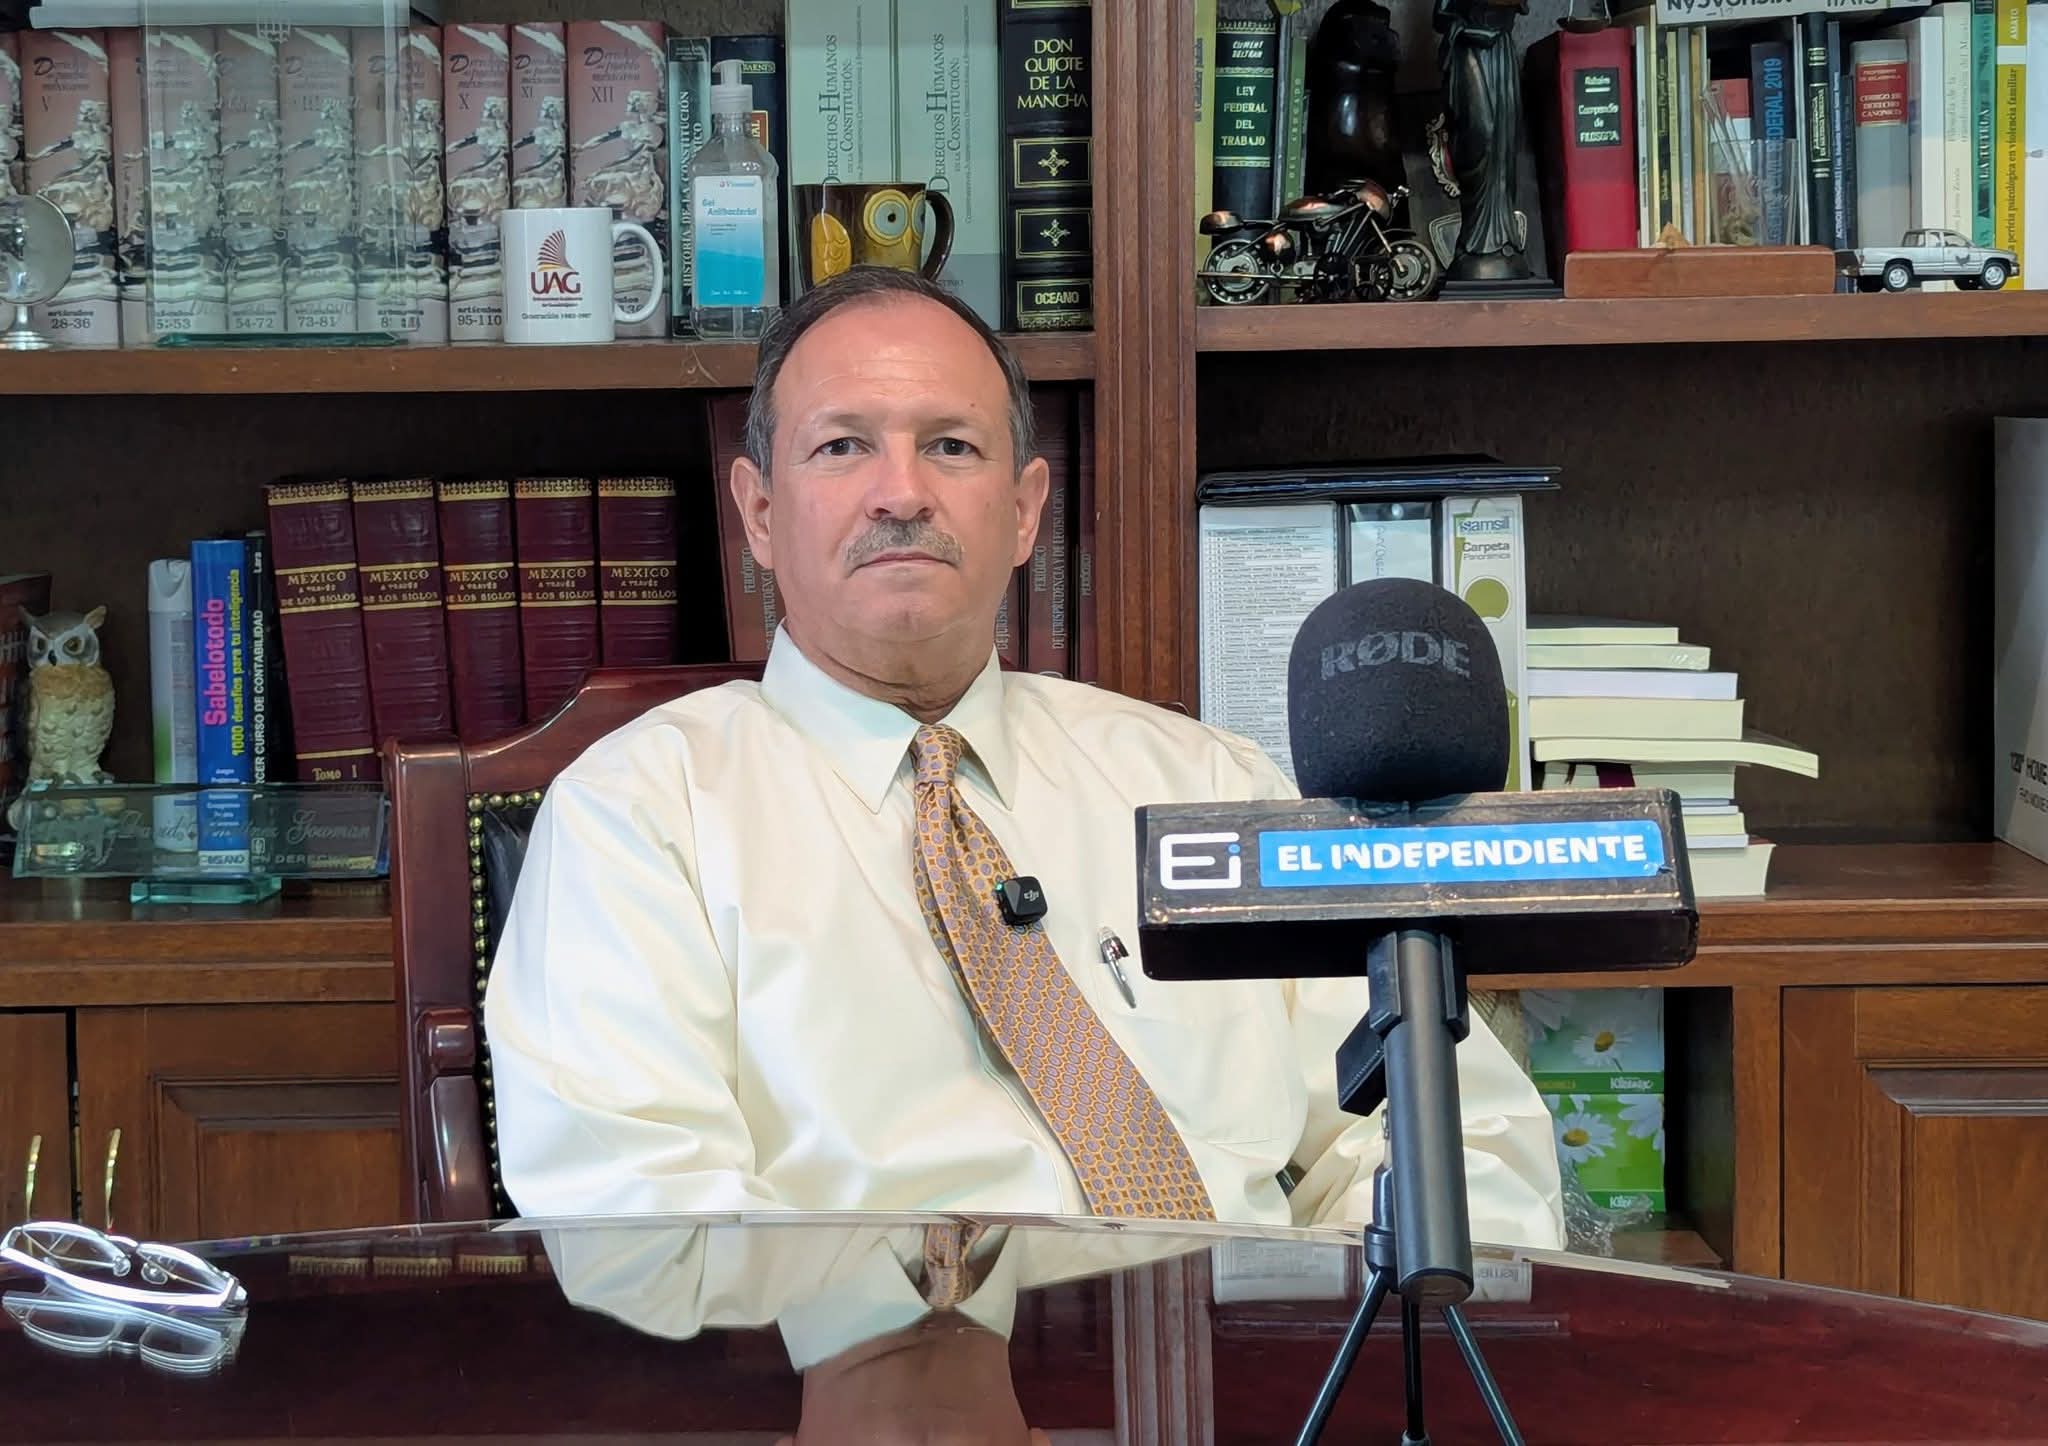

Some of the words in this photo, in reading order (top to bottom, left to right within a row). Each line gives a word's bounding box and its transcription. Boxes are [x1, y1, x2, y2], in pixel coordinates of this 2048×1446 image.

[1034, 39, 1073, 53] DON
[1025, 57, 1084, 73] QUIJOTE
[819, 34, 840, 113] HUMANOS
[926, 33, 948, 113] HUMANOS
[1763, 58, 1783, 88] 2019
[1030, 76, 1049, 90] DE
[1056, 75, 1075, 89] LA
[521, 86, 534, 98] XI
[591, 86, 614, 103] XII
[1236, 86, 1256, 96] LEY
[459, 94, 470, 110] X
[1017, 95, 1088, 109] MANCHA
[1223, 102, 1268, 113] FEDERAL
[1235, 119, 1255, 129] DEL
[1764, 92, 1784, 153] FEDERAL
[2006, 107, 2017, 148] violencia
[679, 91, 691, 181] CONSTITUCIÓN
[1221, 135, 1266, 146] TRABAJO
[1979, 108, 1990, 160] TUTELA
[928, 114, 949, 192] DERECHOS
[2008, 151, 2016, 161] en
[1979, 163, 1989, 179] LA
[2006, 163, 2018, 211] psicológica
[681, 187, 691, 203] LA
[681, 210, 691, 224] DE
[2006, 213, 2017, 243] pericia
[681, 230, 692, 286] HISTORIA
[531, 271, 581, 295] UAG
[1035, 291, 1080, 305] OCEANO
[235, 318, 274, 329] 54-72
[457, 315, 502, 326] 95-110
[1463, 542, 1510, 554] Carpeta
[252, 551, 263, 573] Lara
[288, 571, 347, 585] MEXICO
[369, 569, 430, 583] MEXICO
[450, 569, 509, 583] MEXICO
[528, 568, 587, 579] MEXICO
[610, 568, 670, 578] MEXICO
[228, 569, 243, 631] inteligencia
[297, 595, 316, 605] LOS
[320, 593, 357, 603] SIGLOS
[379, 594, 398, 603] LOS
[402, 592, 438, 601] SIGLOS
[458, 594, 477, 602] LOS
[481, 592, 516, 601] SIGLOS
[536, 591, 555, 600] LOS
[560, 590, 595, 600] SIGLOS
[619, 591, 638, 599] LOS
[641, 590, 677, 599] SIGLOS
[1052, 566, 1066, 637] JURISPRUDENCIA
[229, 632, 241, 646] tu
[1053, 638, 1065, 649] DE
[252, 610, 264, 693] CONTABILIDAD
[203, 599, 227, 726] Sabelotodo
[230, 649, 243, 674] para
[253, 696, 264, 711] DE
[232, 725, 245, 756] 1000
[253, 712, 264, 754] CURSO
[252, 756, 265, 800] TRCER
[312, 767, 342, 782] Tomo
[1278, 844, 1322, 872] EL
[1332, 834, 1648, 870] INDEPENDIENTE
